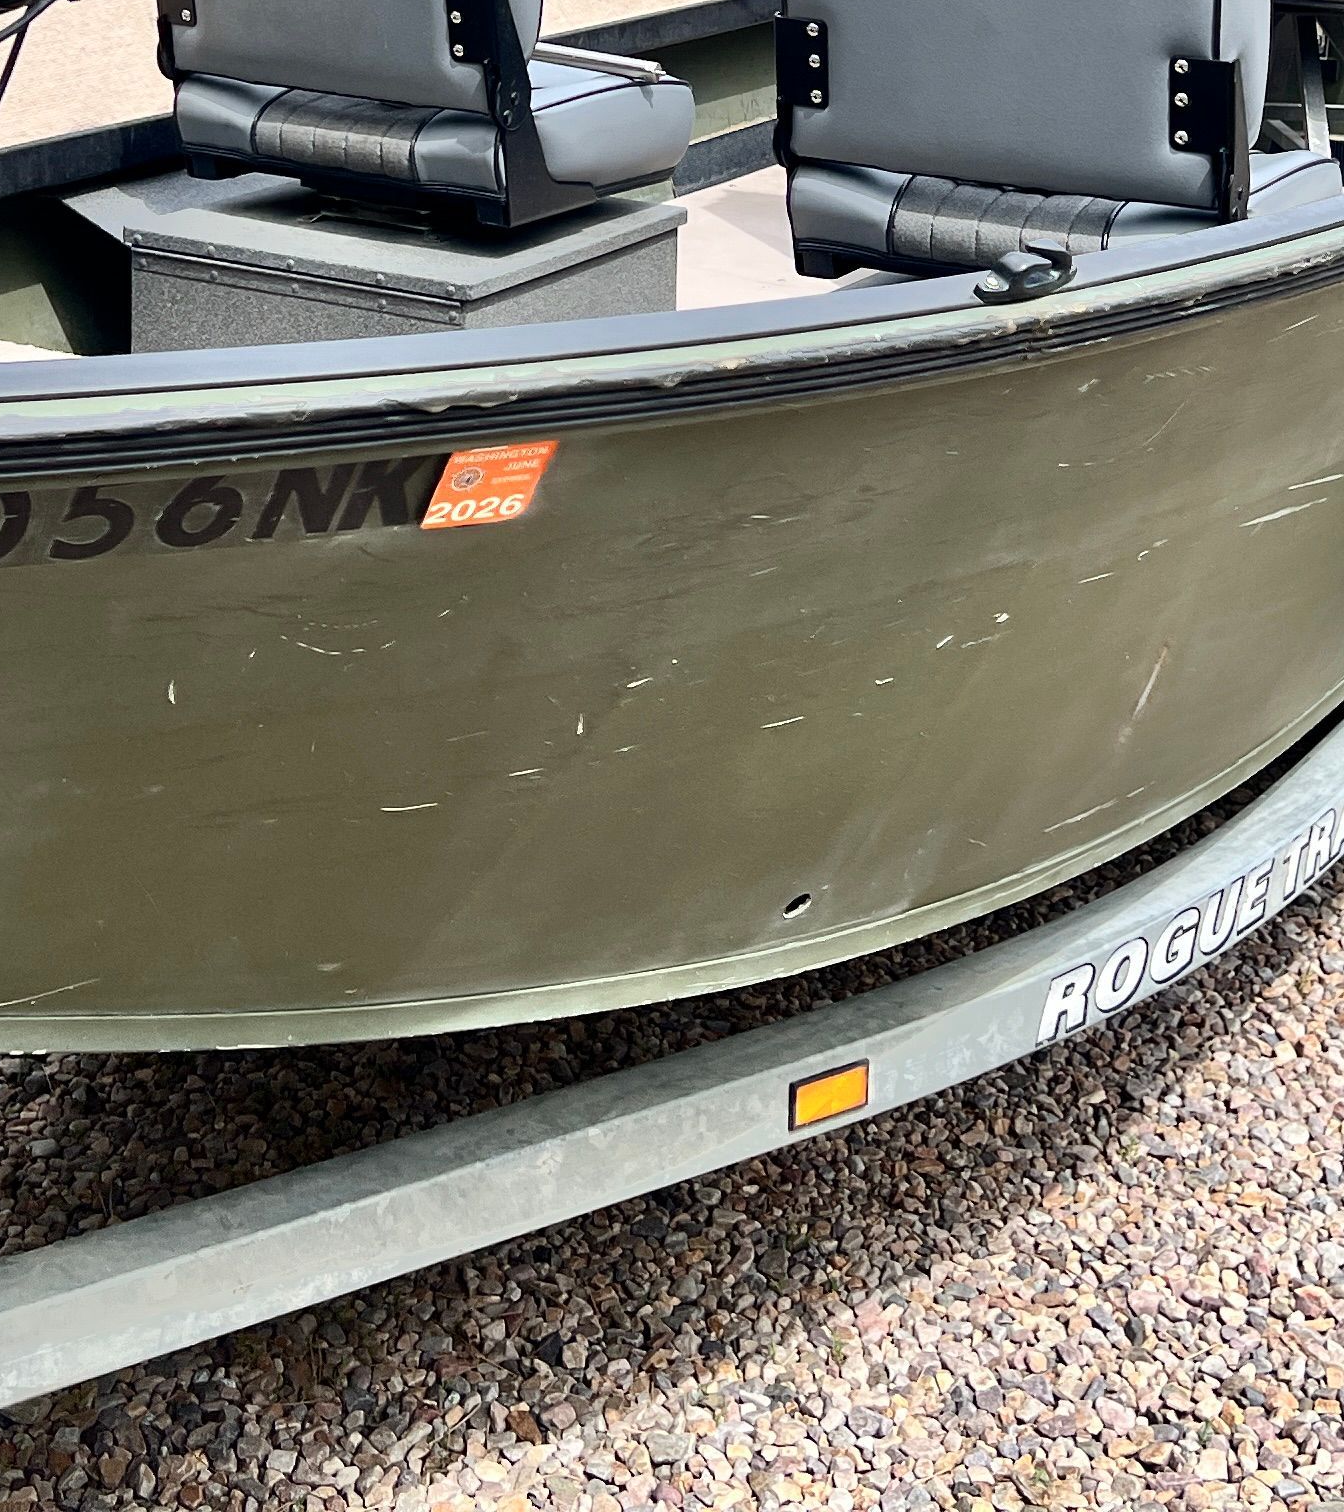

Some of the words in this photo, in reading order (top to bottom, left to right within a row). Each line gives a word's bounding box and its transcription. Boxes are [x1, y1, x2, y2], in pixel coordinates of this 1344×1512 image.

[452, 446, 550, 465] WASHINGTON
[423, 493, 525, 525] 2026
[1035, 858, 1277, 1048] ROGUE
